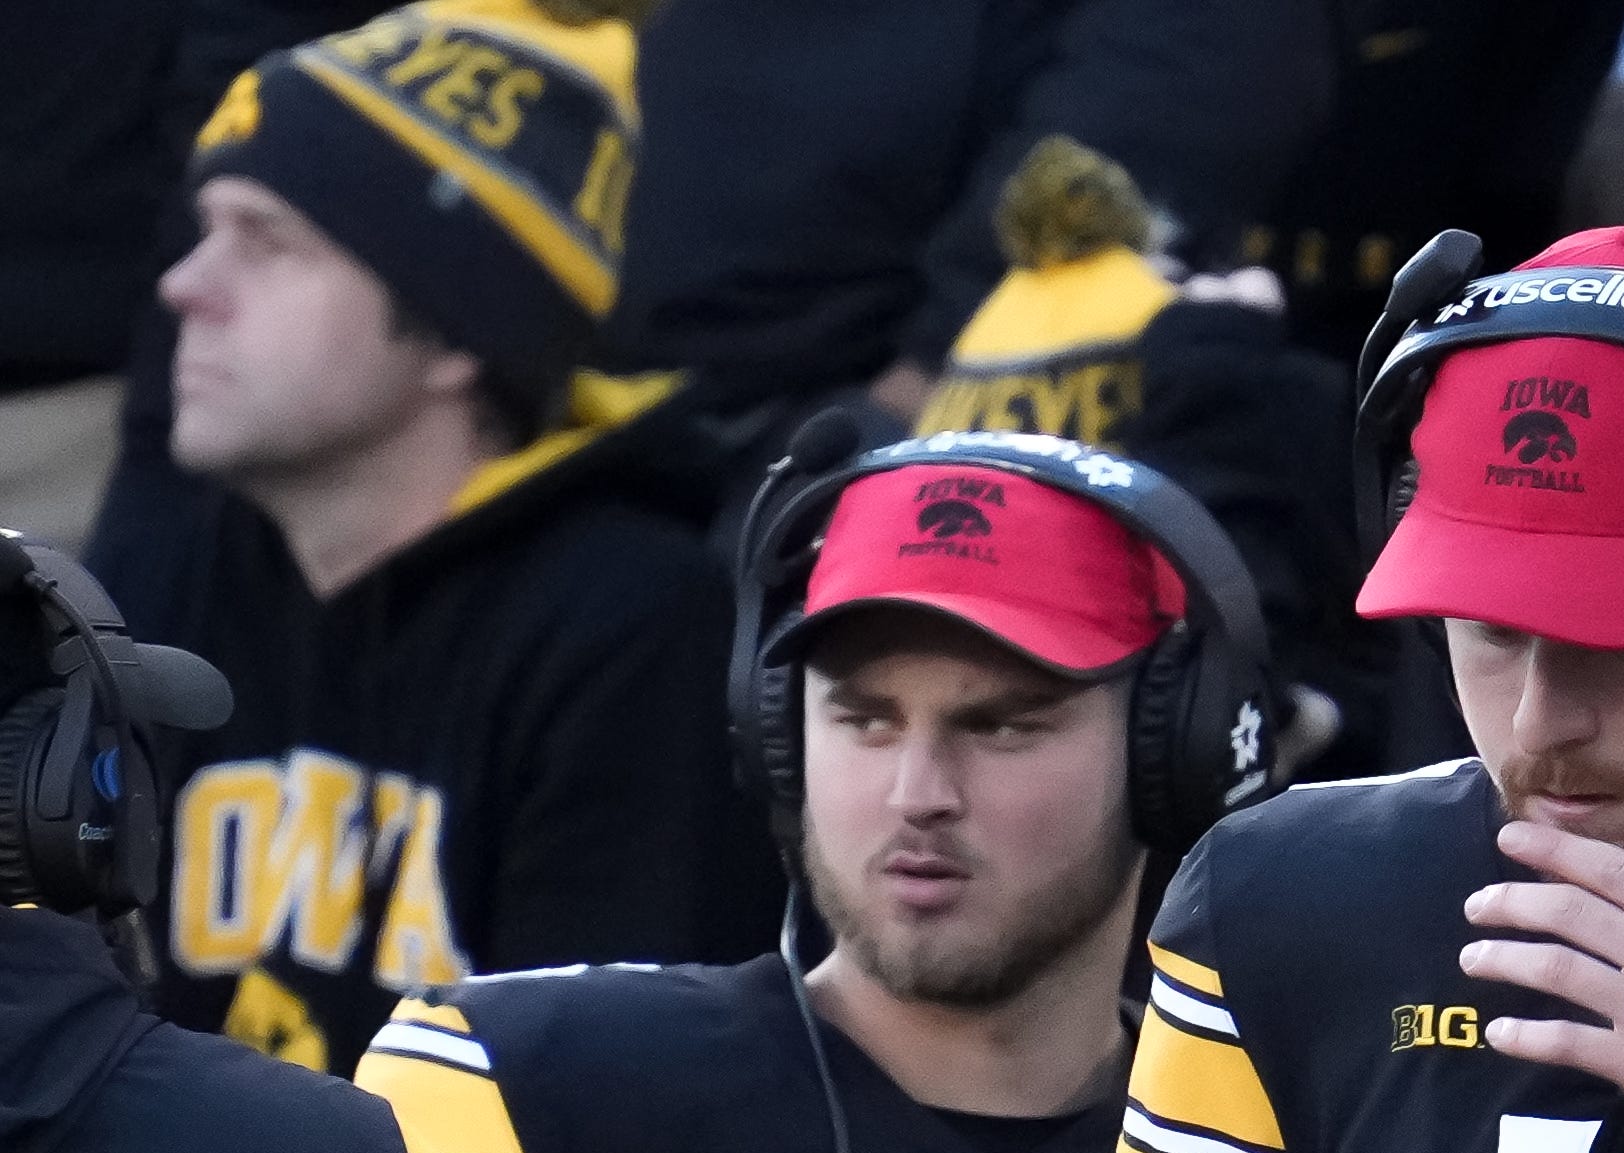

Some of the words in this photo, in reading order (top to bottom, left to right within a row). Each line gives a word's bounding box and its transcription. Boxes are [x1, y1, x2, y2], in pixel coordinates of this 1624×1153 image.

[1500, 376, 1592, 419] IOWA
[913, 478, 1007, 508] IOWA
[1484, 464, 1586, 493] FOOTBALL
[170, 747, 471, 993] OWA
